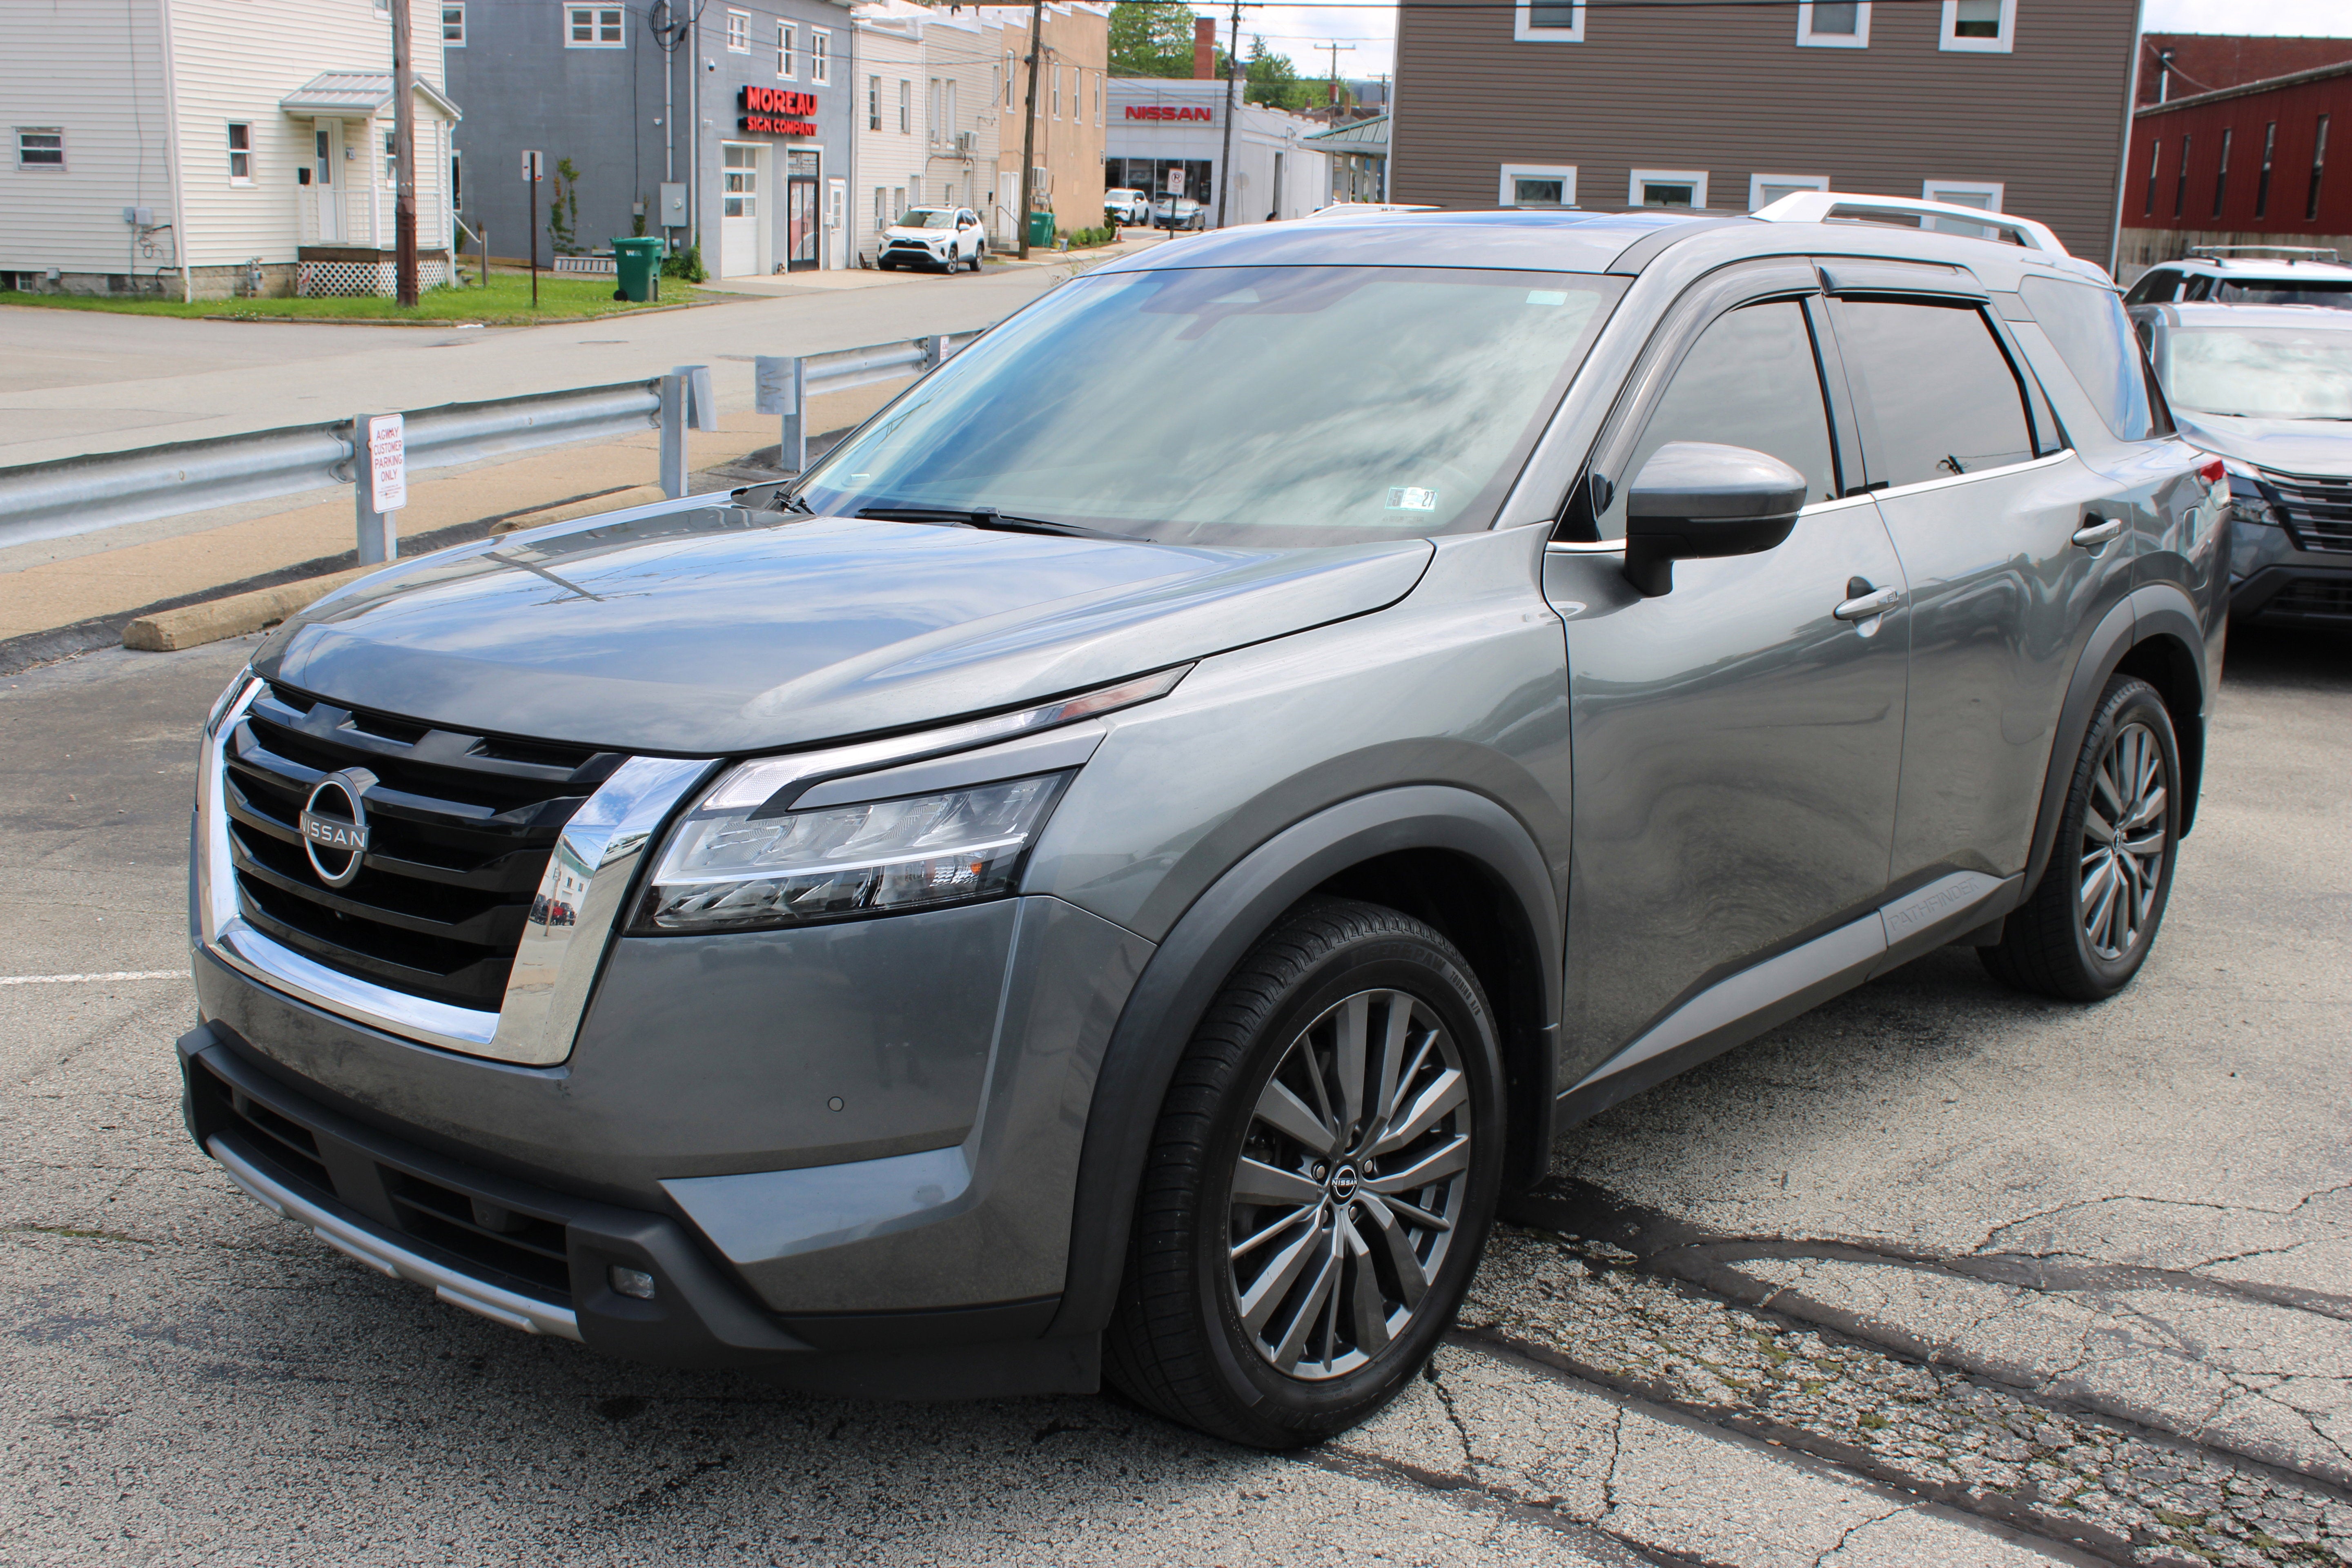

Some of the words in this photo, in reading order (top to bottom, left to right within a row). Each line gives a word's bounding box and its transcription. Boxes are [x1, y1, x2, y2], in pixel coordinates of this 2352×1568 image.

[747, 85, 817, 116] MOREAU
[1125, 105, 1211, 120] NISSAN
[747, 116, 772, 131] SIGN
[773, 118, 817, 136] COMPANY
[376, 426, 399, 441] AGWAY
[374, 440, 402, 456] CUSTOMER
[374, 454, 403, 469] PARKING
[381, 469, 397, 482] ONLY
[1421, 491, 1435, 508] 27
[300, 815, 365, 848] NISSAN
[1887, 877, 1980, 931] PATHFINDER
